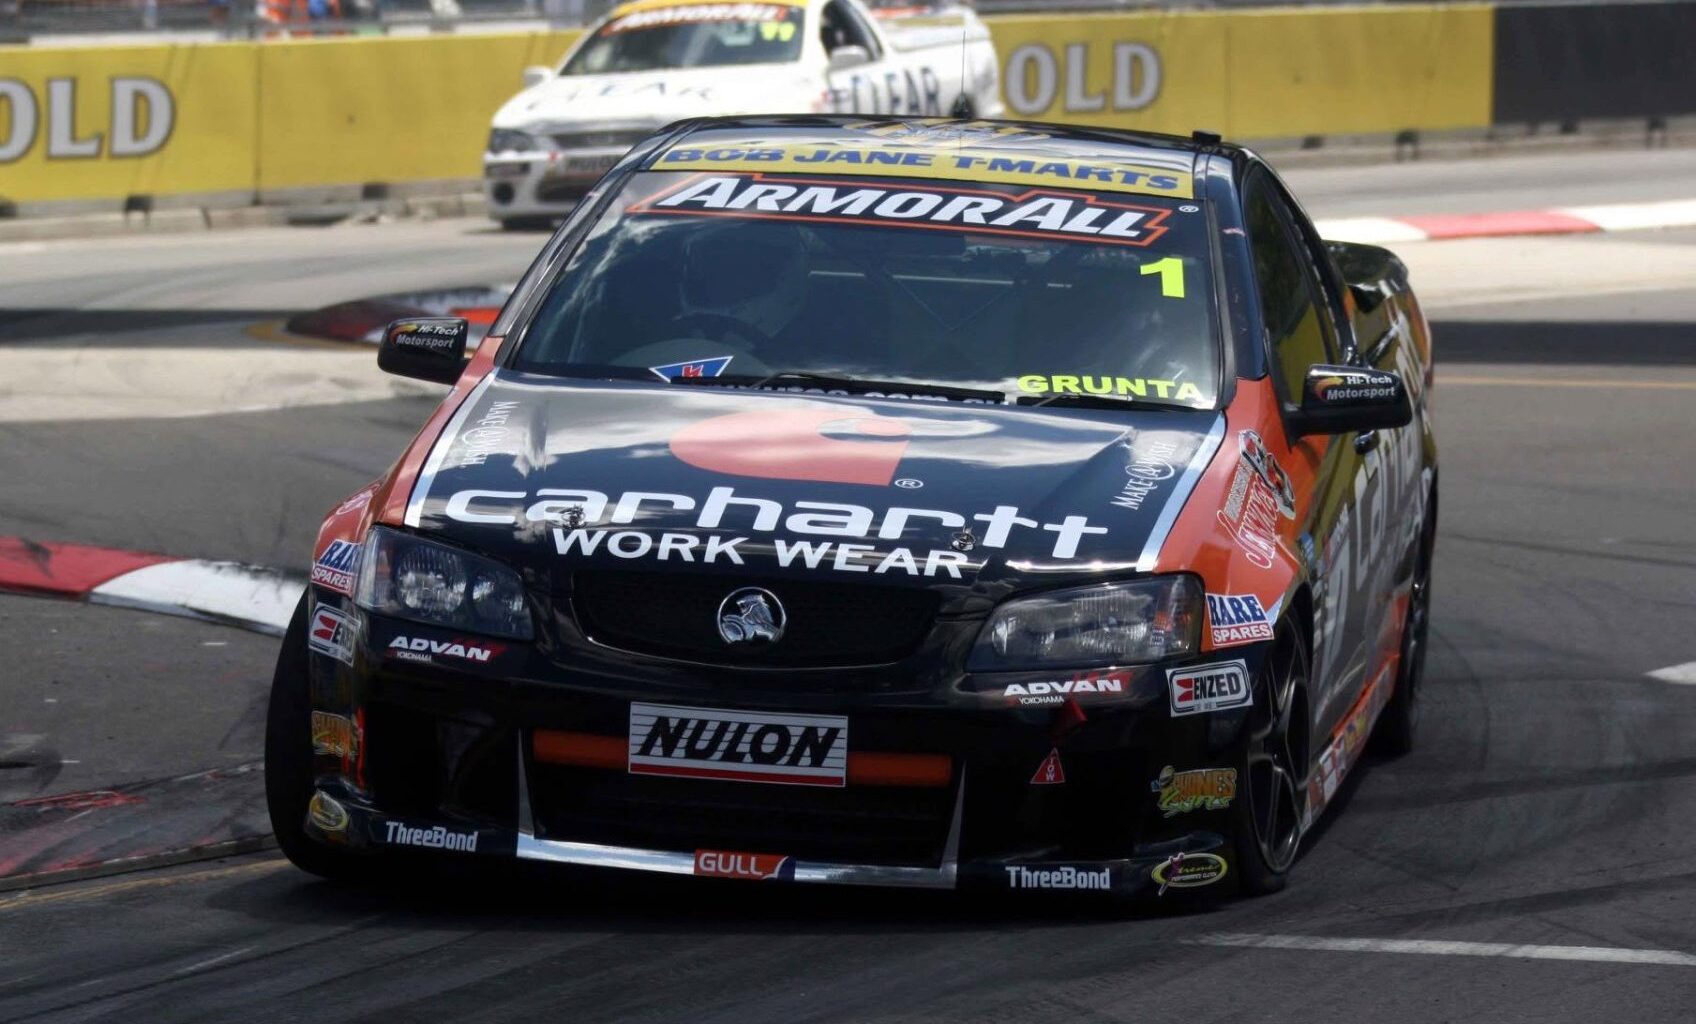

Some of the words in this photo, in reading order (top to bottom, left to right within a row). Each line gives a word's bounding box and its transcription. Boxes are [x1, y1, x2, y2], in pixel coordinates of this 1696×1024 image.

[662, 148, 787, 163] BOB
[793, 149, 935, 168] JANE
[954, 156, 1178, 190] T-MARTS
[1140, 257, 1185, 298] 1
[396, 334, 455, 349] Motorsport
[417, 324, 459, 336] Hi-Tech
[1016, 375, 1203, 402] GRUNTA
[1326, 386, 1395, 400] Motorsport
[1346, 375, 1392, 385] Hi-Tech
[1109, 478, 1158, 511] MAKE
[445, 486, 1107, 560] carhartt
[552, 527, 747, 566] WORK
[774, 539, 969, 579] WEAR
[1207, 595, 1268, 627] RARE
[1213, 624, 1271, 644] SPARES
[388, 635, 492, 661] ADVAN
[1003, 679, 1122, 697] ADVAN
[1193, 673, 1242, 700] ENZED
[1019, 695, 1065, 705] YOKOHAMA
[637, 714, 841, 768] NULON
[386, 820, 478, 852] ThreeBond
[699, 852, 764, 877] GULL
[1005, 865, 1111, 889] ThreeBond
